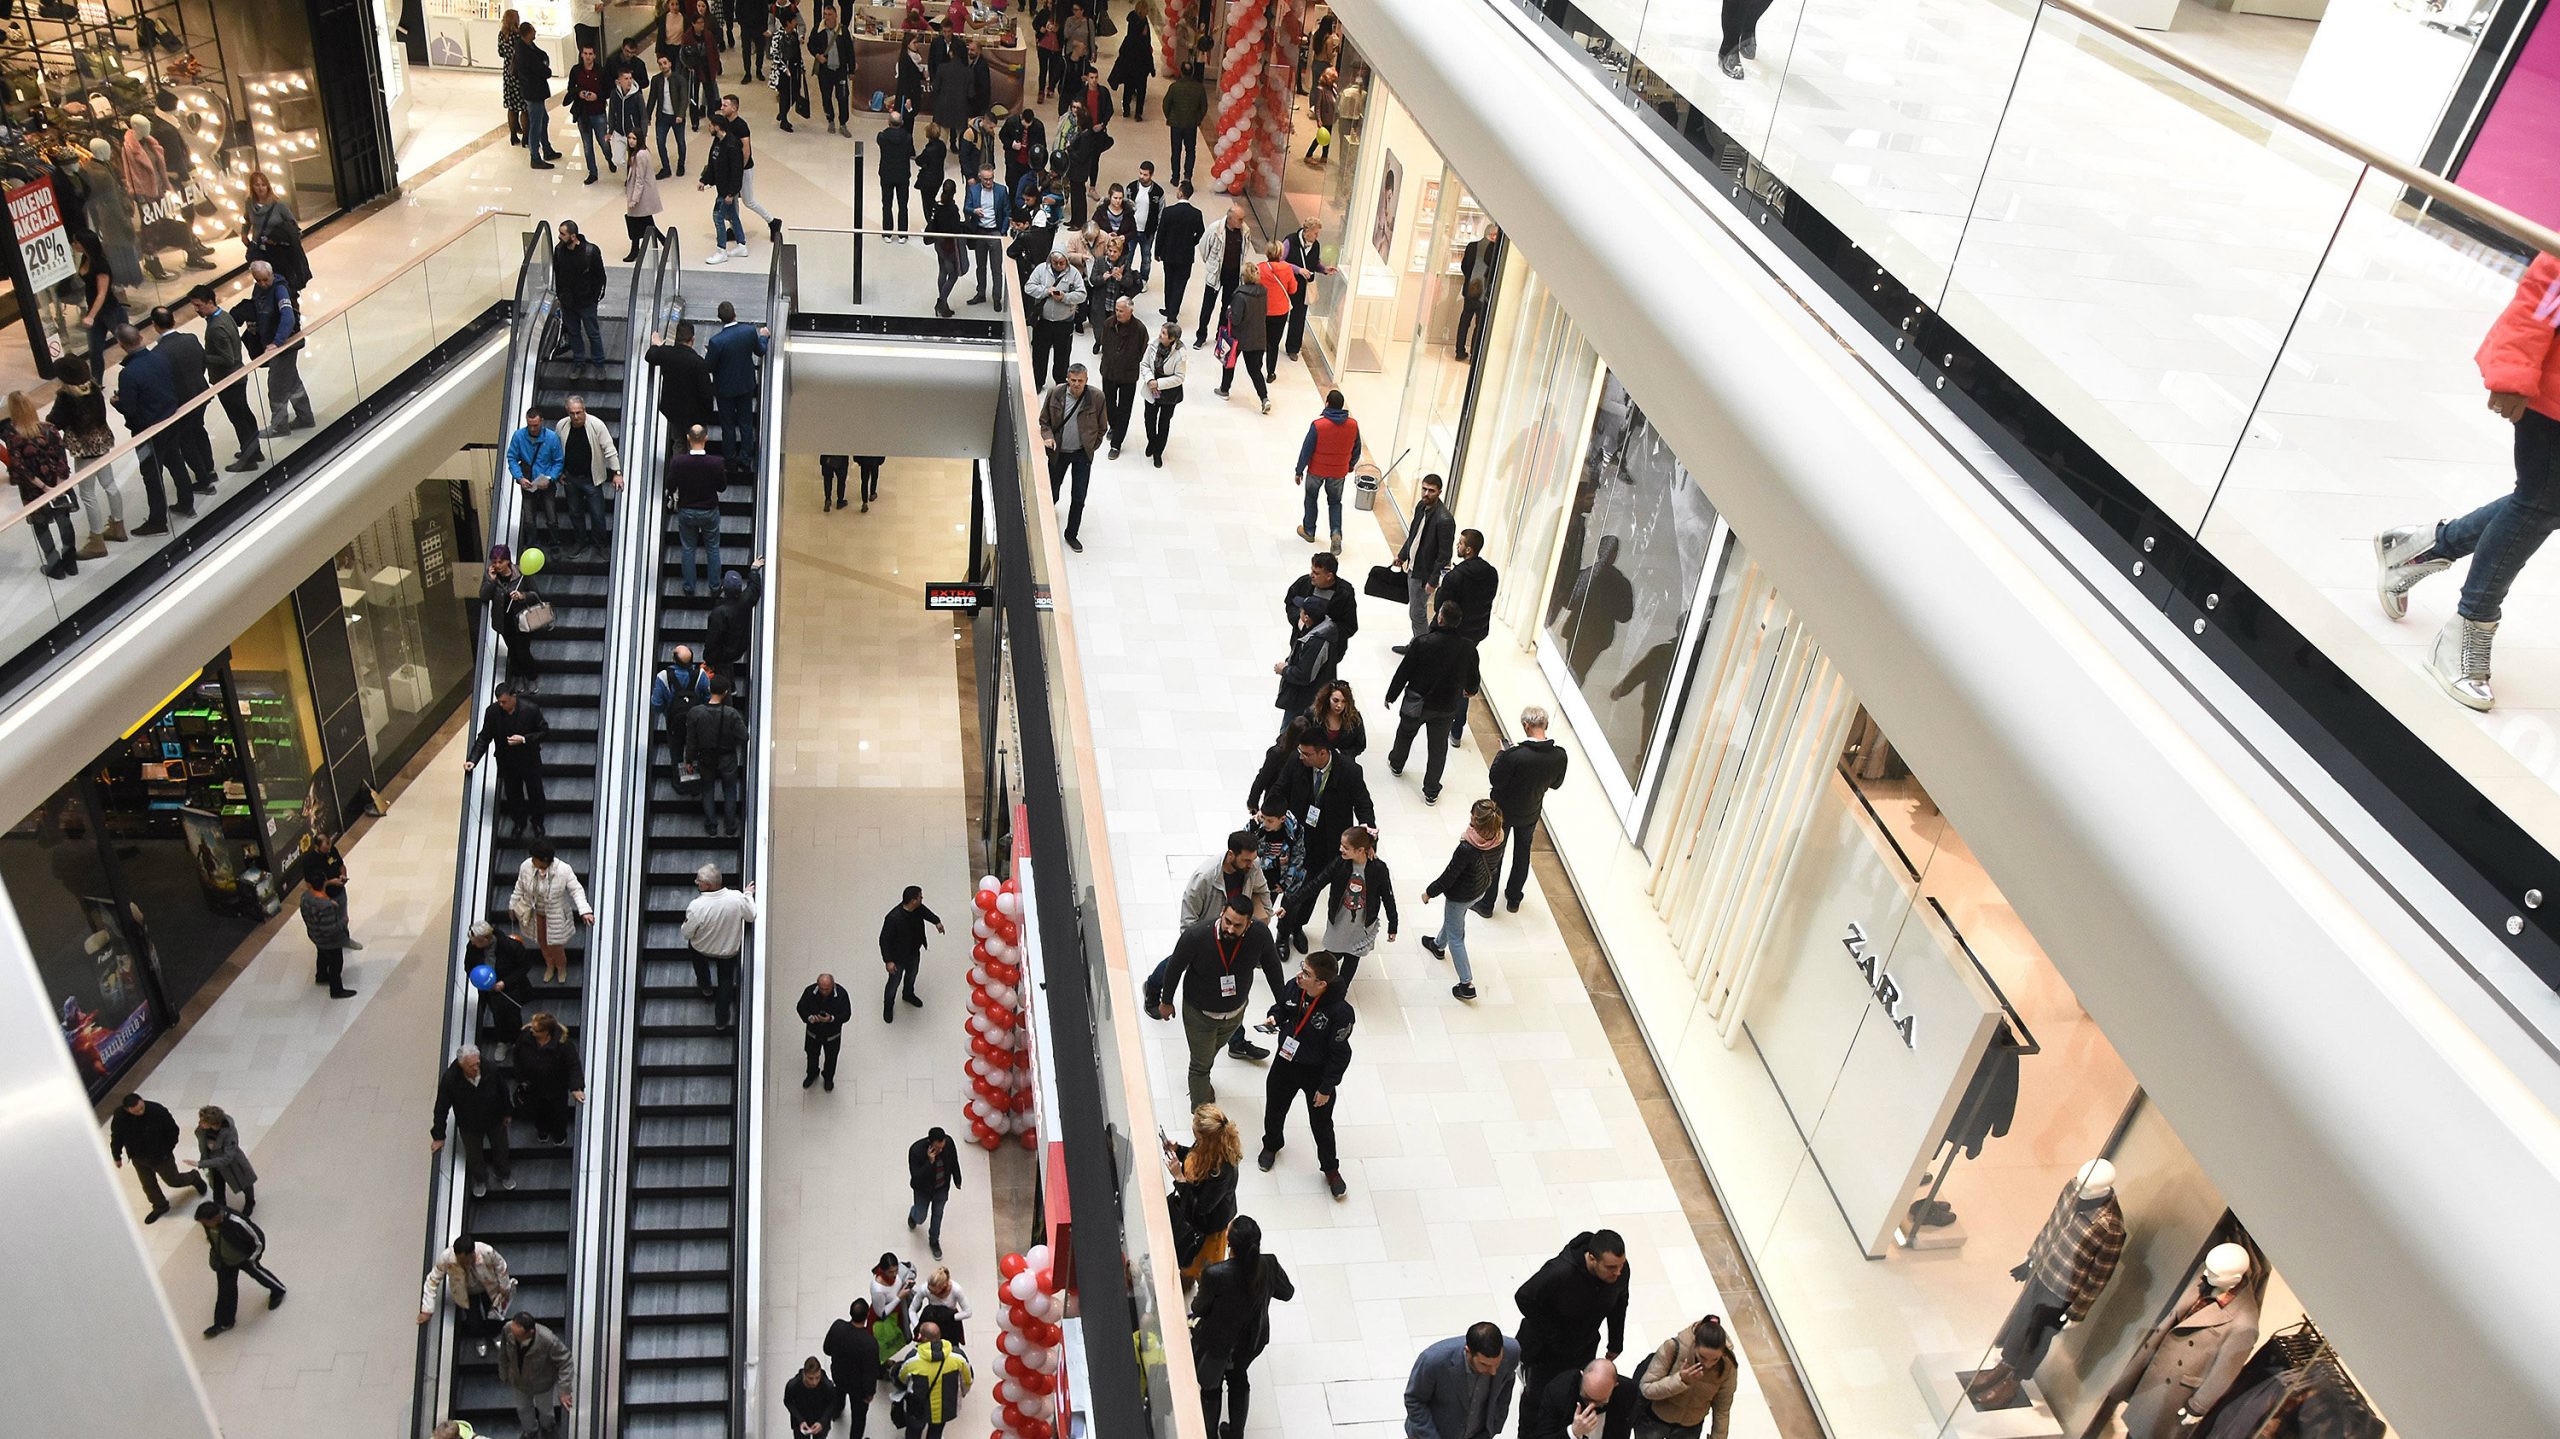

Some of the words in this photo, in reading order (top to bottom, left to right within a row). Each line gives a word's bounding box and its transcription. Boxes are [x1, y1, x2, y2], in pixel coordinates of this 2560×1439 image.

[7, 186, 53, 220] VIKEND
[13, 205, 59, 241] AKCIJA
[25, 232, 65, 271] 20%
[930, 596, 977, 605] SPORTS
[1842, 922, 1916, 1049] ZARA
[100, 1018, 141, 1065] BATTLEFIELD
[139, 1011, 147, 1022] V
